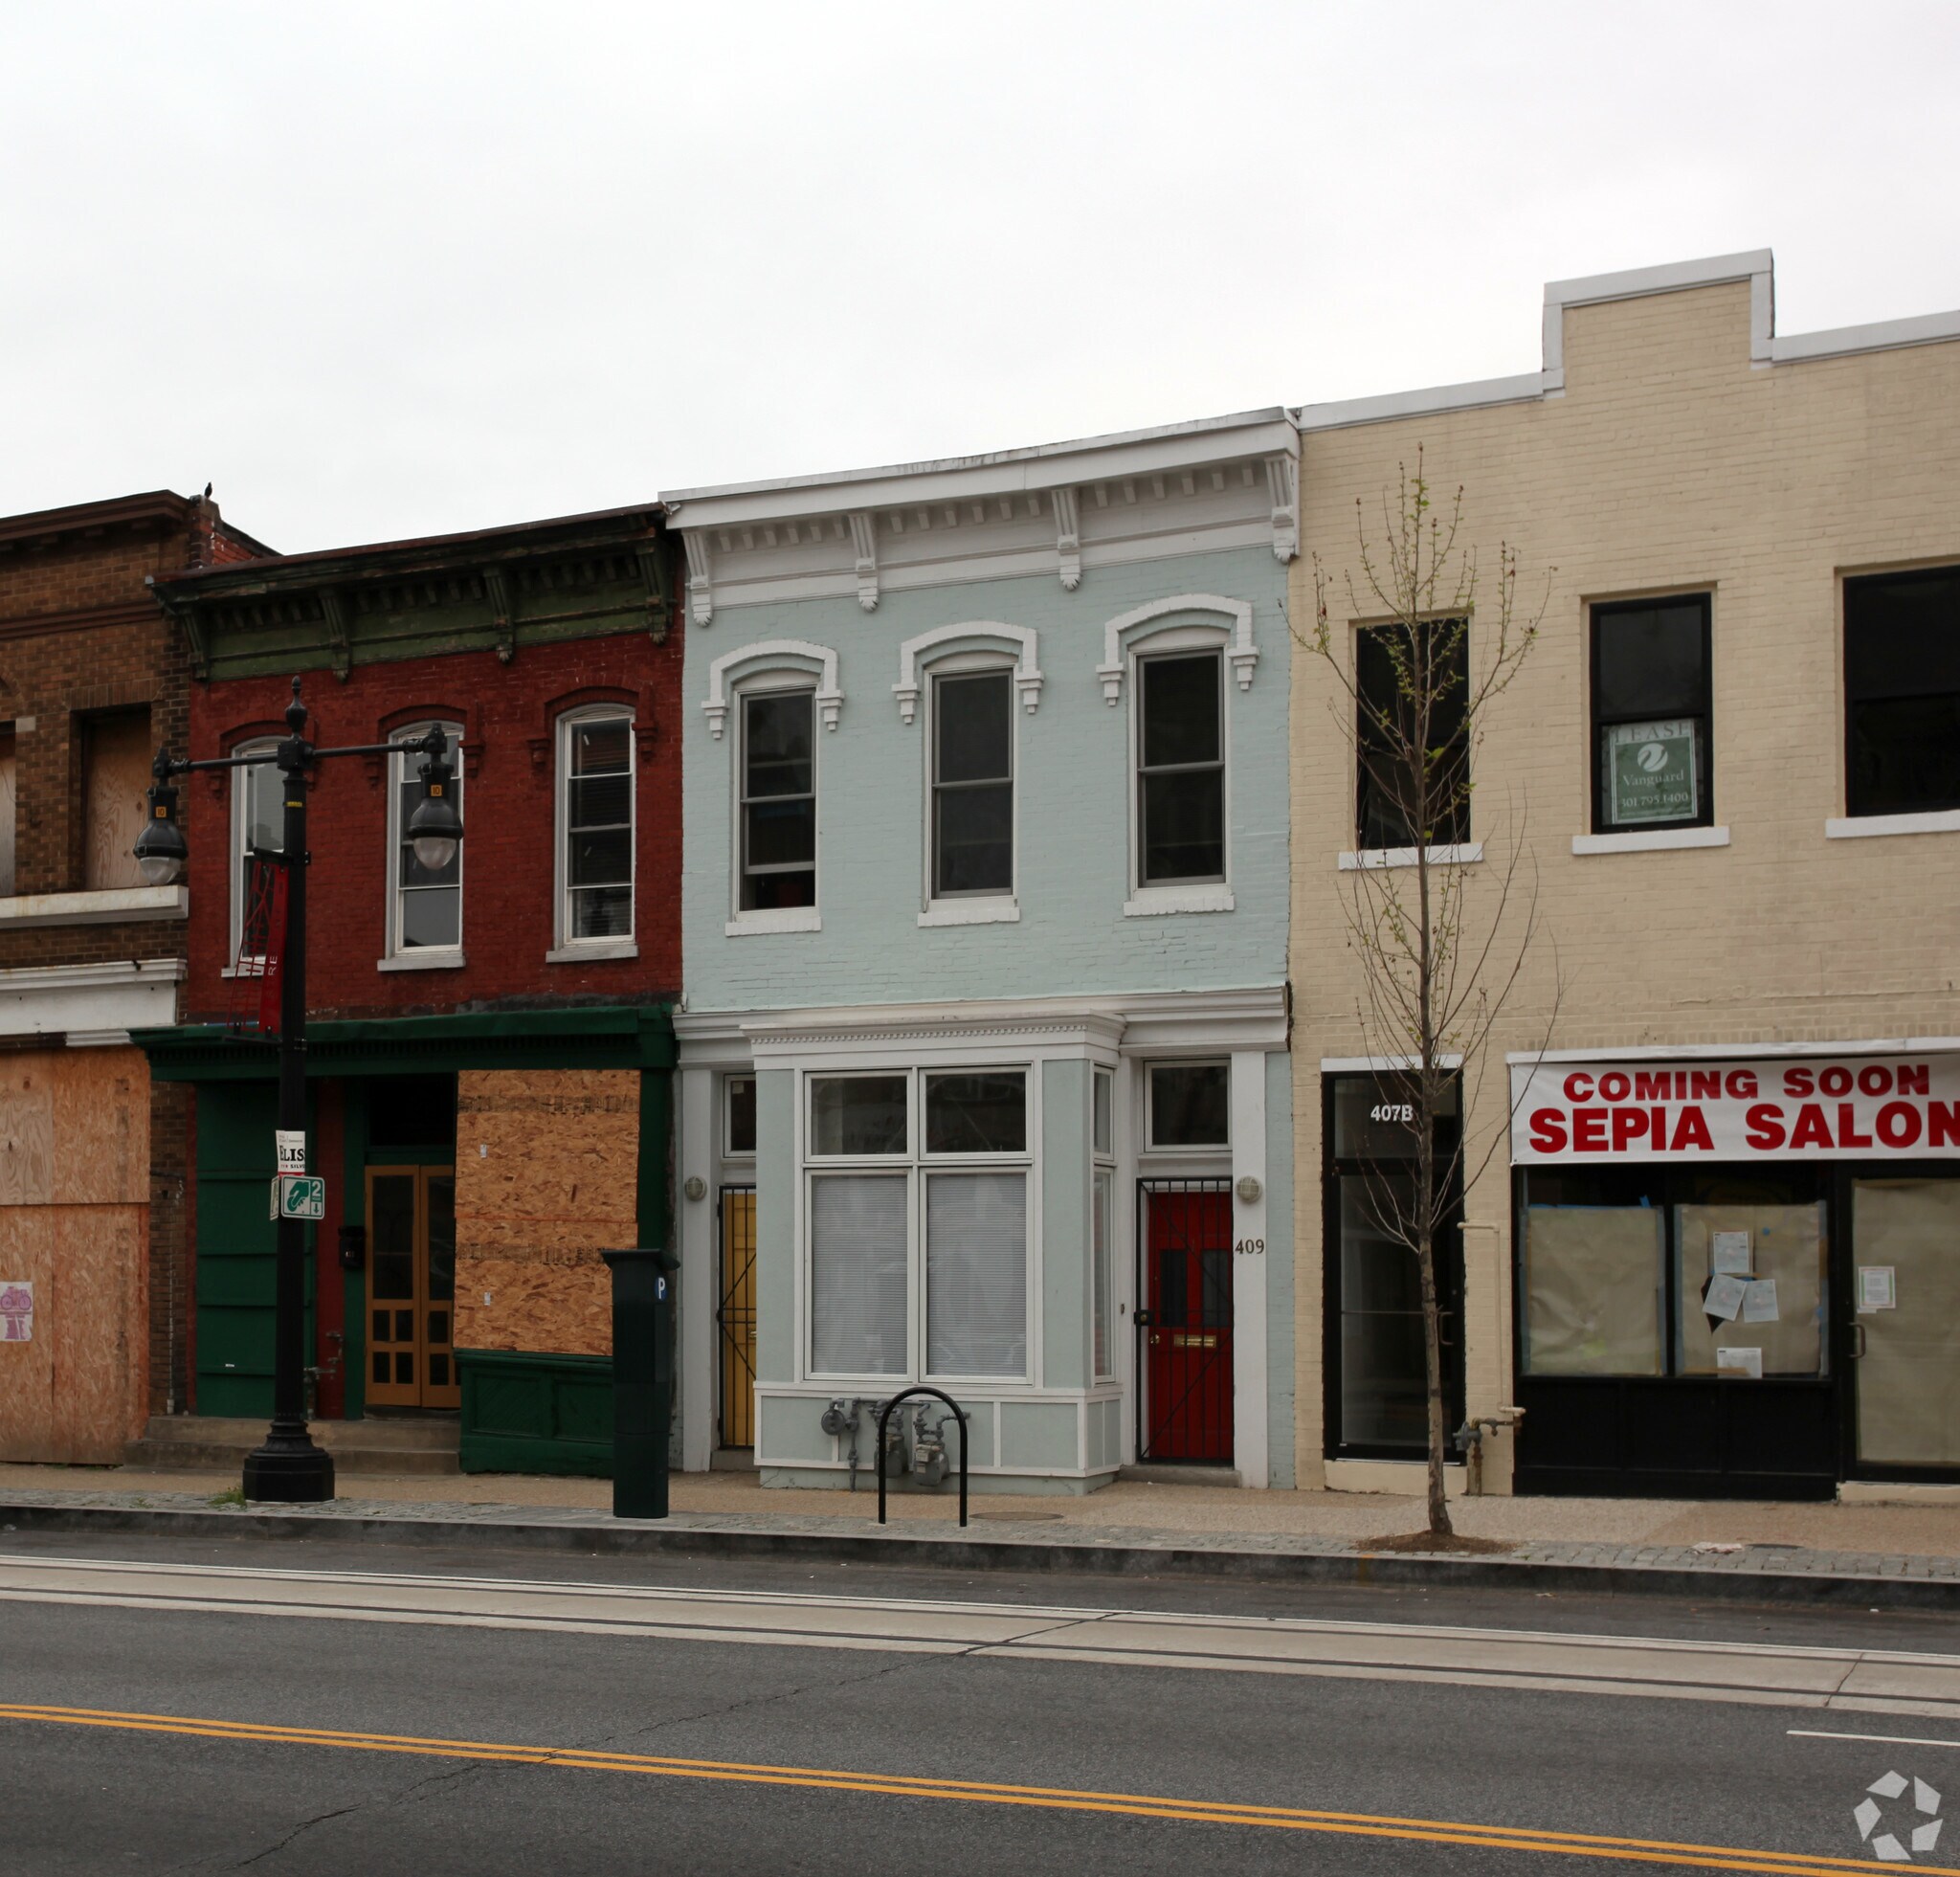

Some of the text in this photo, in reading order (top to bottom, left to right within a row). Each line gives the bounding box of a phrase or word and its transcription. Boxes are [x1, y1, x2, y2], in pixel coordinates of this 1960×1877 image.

[1623, 769, 1684, 787] Vanguard
[1563, 1064, 1930, 1103] COMING SOON
[1370, 1105, 1414, 1122] 407B
[1528, 1100, 1960, 1154] SEPIA SALON
[311, 1180, 322, 1197] 2
[1235, 1239, 1265, 1255] 409
[657, 1277, 666, 1300] P
